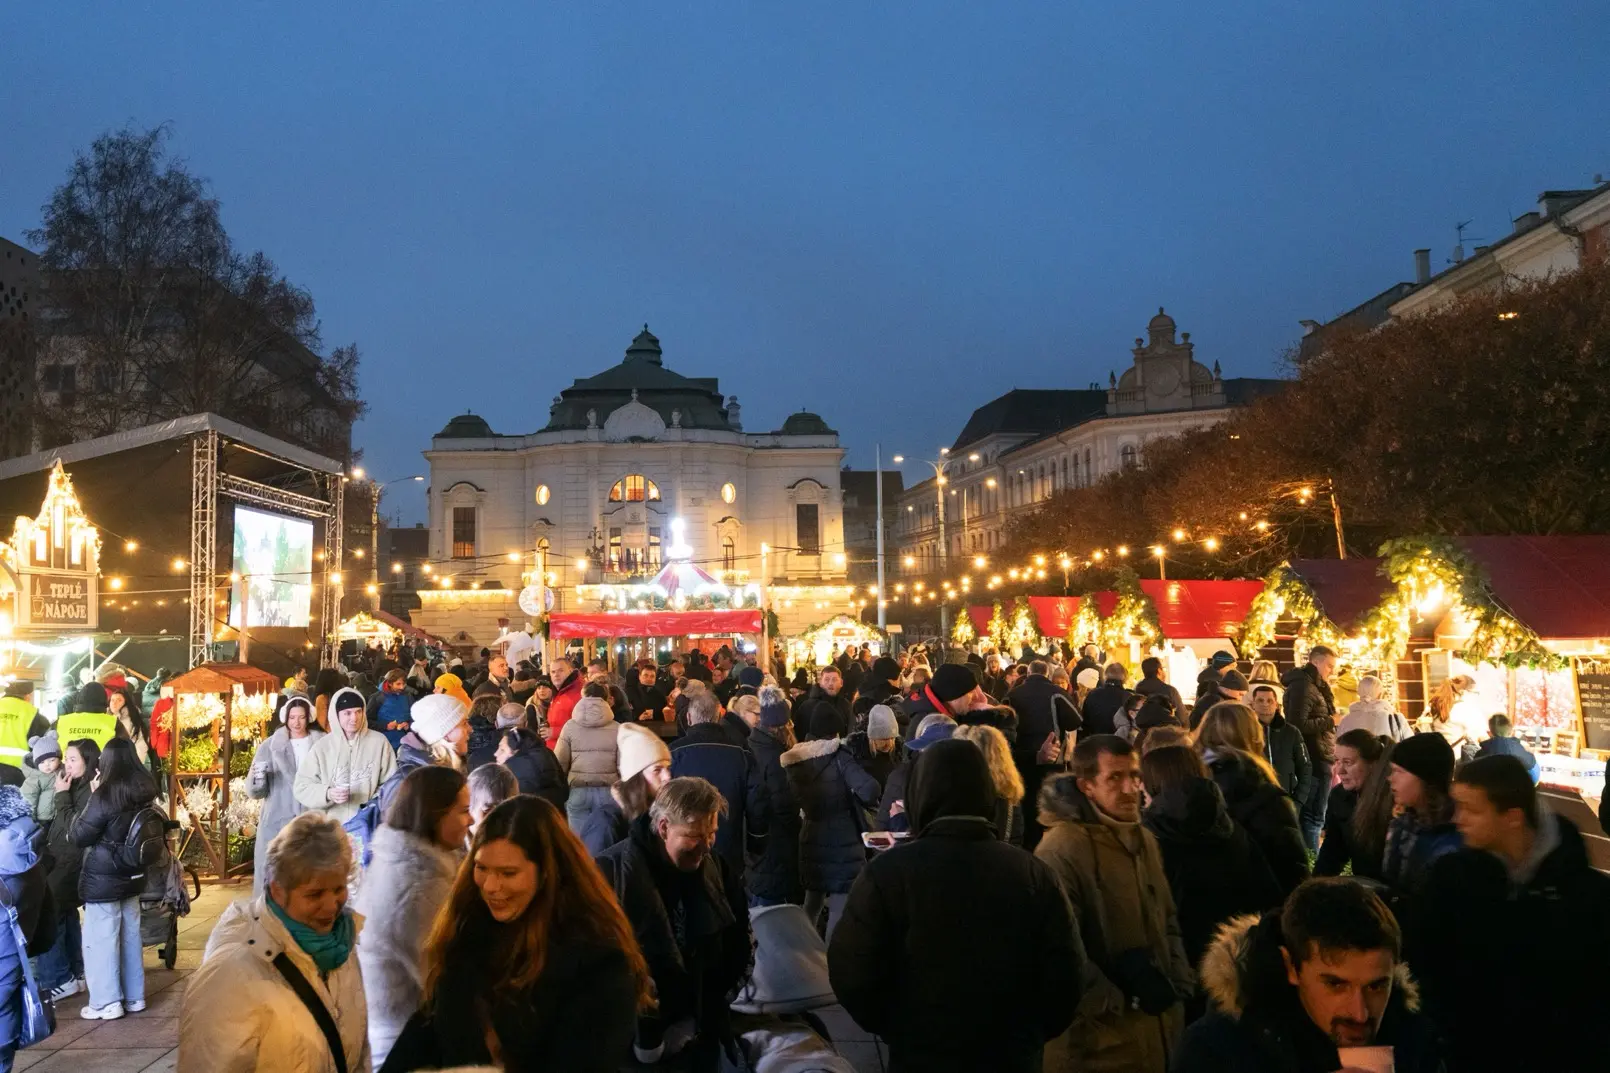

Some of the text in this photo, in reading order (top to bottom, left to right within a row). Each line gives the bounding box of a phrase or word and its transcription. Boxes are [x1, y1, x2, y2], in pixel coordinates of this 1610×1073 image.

[50, 581, 82, 599] TEPLÉ
[45, 600, 87, 618] NÁPOJE
[69, 727, 102, 735] SECURITY
